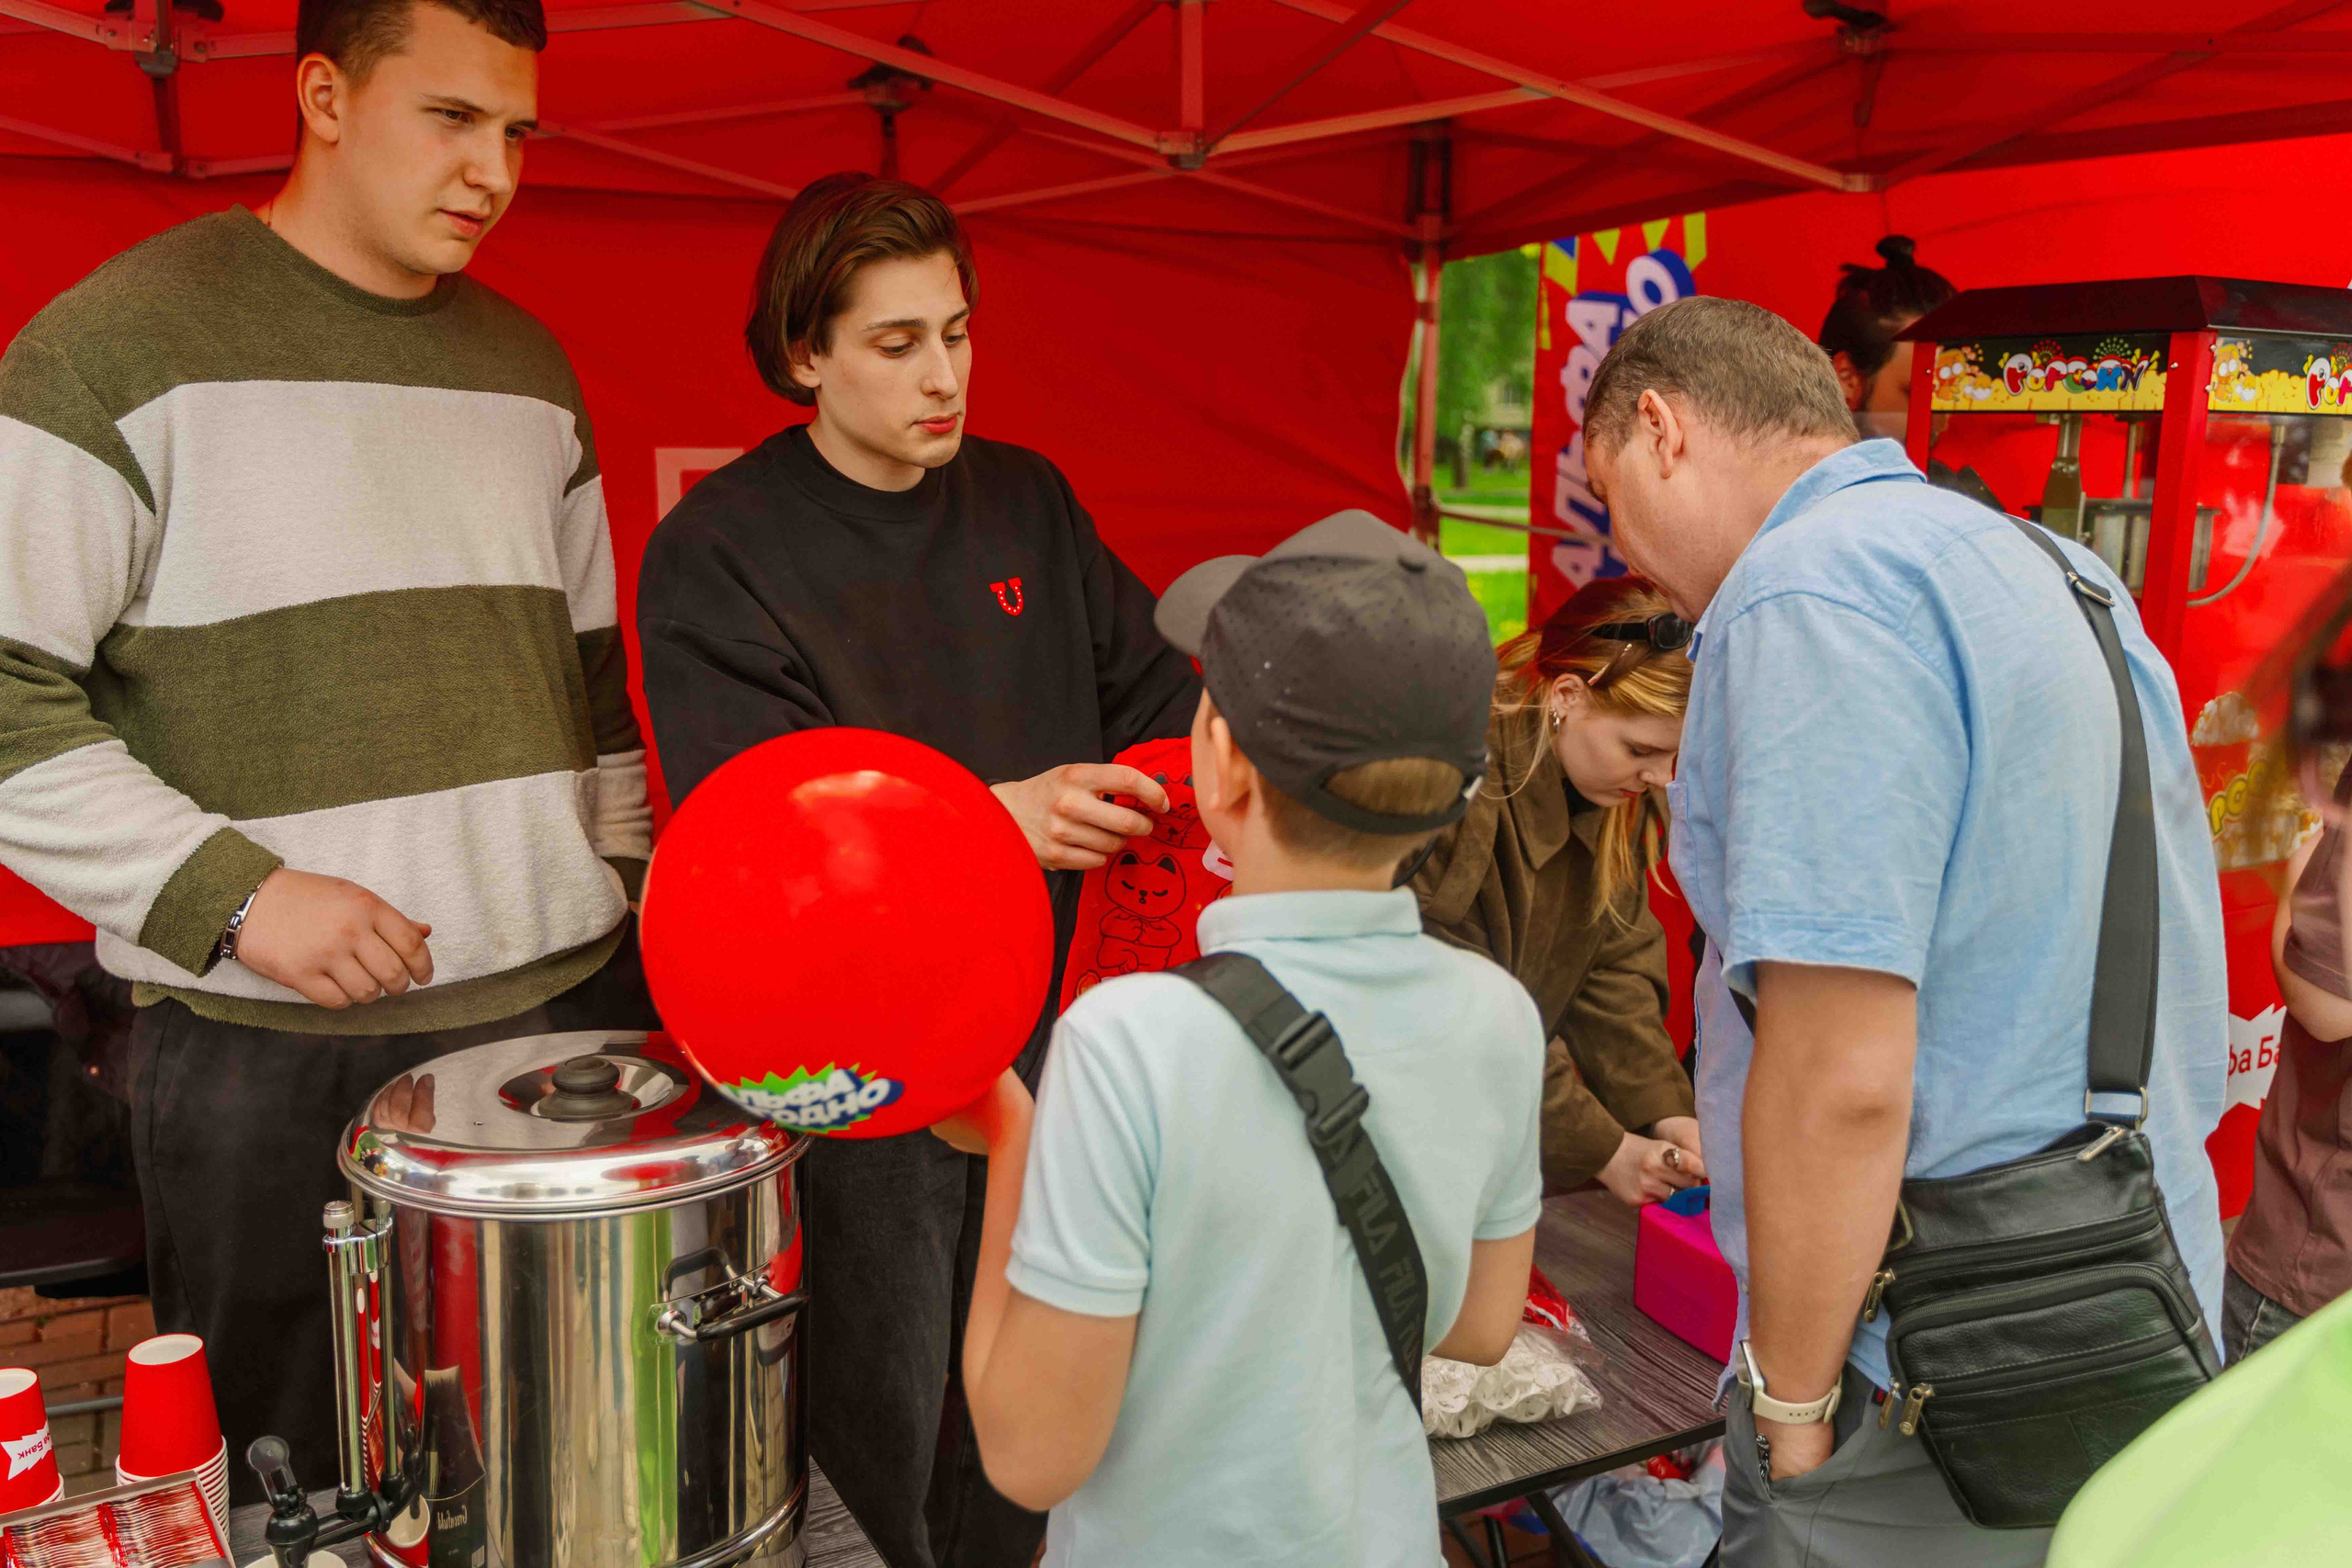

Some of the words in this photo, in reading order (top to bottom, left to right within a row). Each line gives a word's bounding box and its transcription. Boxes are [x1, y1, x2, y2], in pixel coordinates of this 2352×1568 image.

[1348, 1169, 1398, 1256] FILA
[1377, 1256, 1419, 1323] FILA
[17, 1440, 44, 1460] Банк
